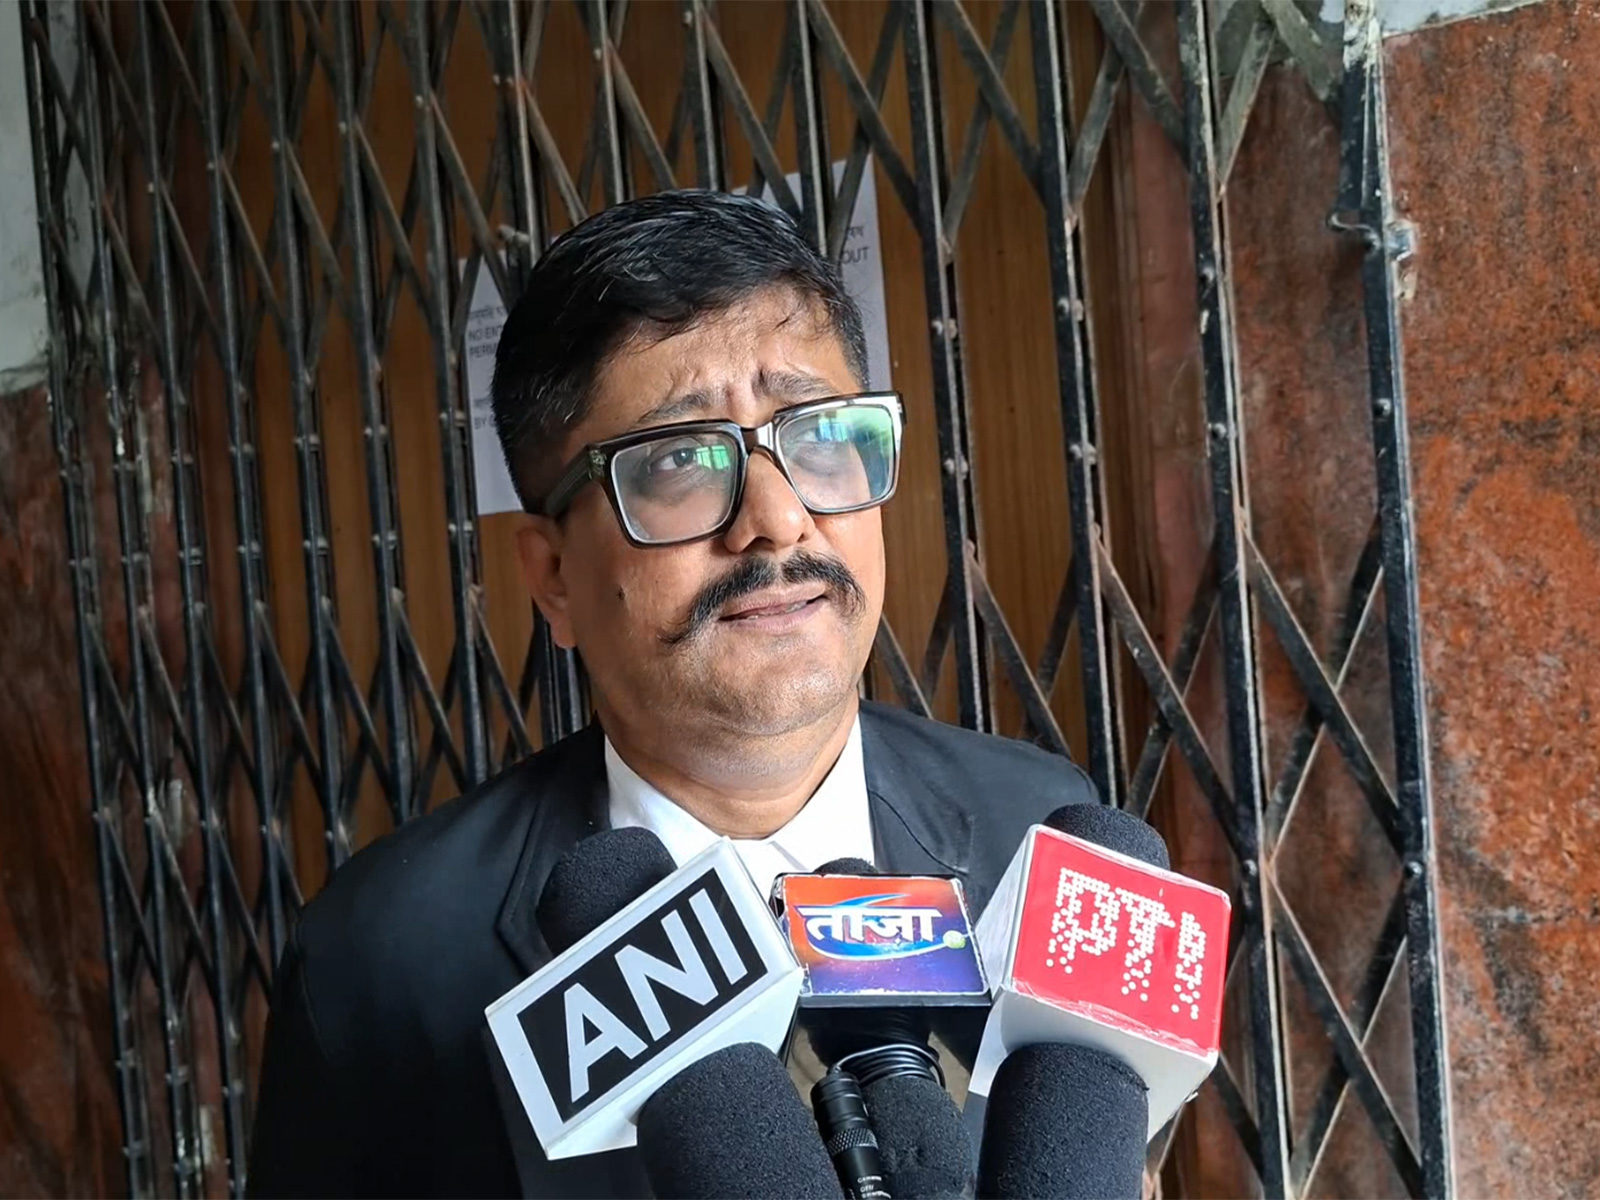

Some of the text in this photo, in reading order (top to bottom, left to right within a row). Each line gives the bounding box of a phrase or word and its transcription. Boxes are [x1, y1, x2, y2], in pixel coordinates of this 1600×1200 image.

[468, 329, 482, 341] NO
[841, 246, 869, 264] OUT
[469, 342, 498, 358] PERM
[796, 906, 943, 942] ताजा
[1046, 866, 1206, 1020] PTI
[564, 888, 748, 1103] ANI
